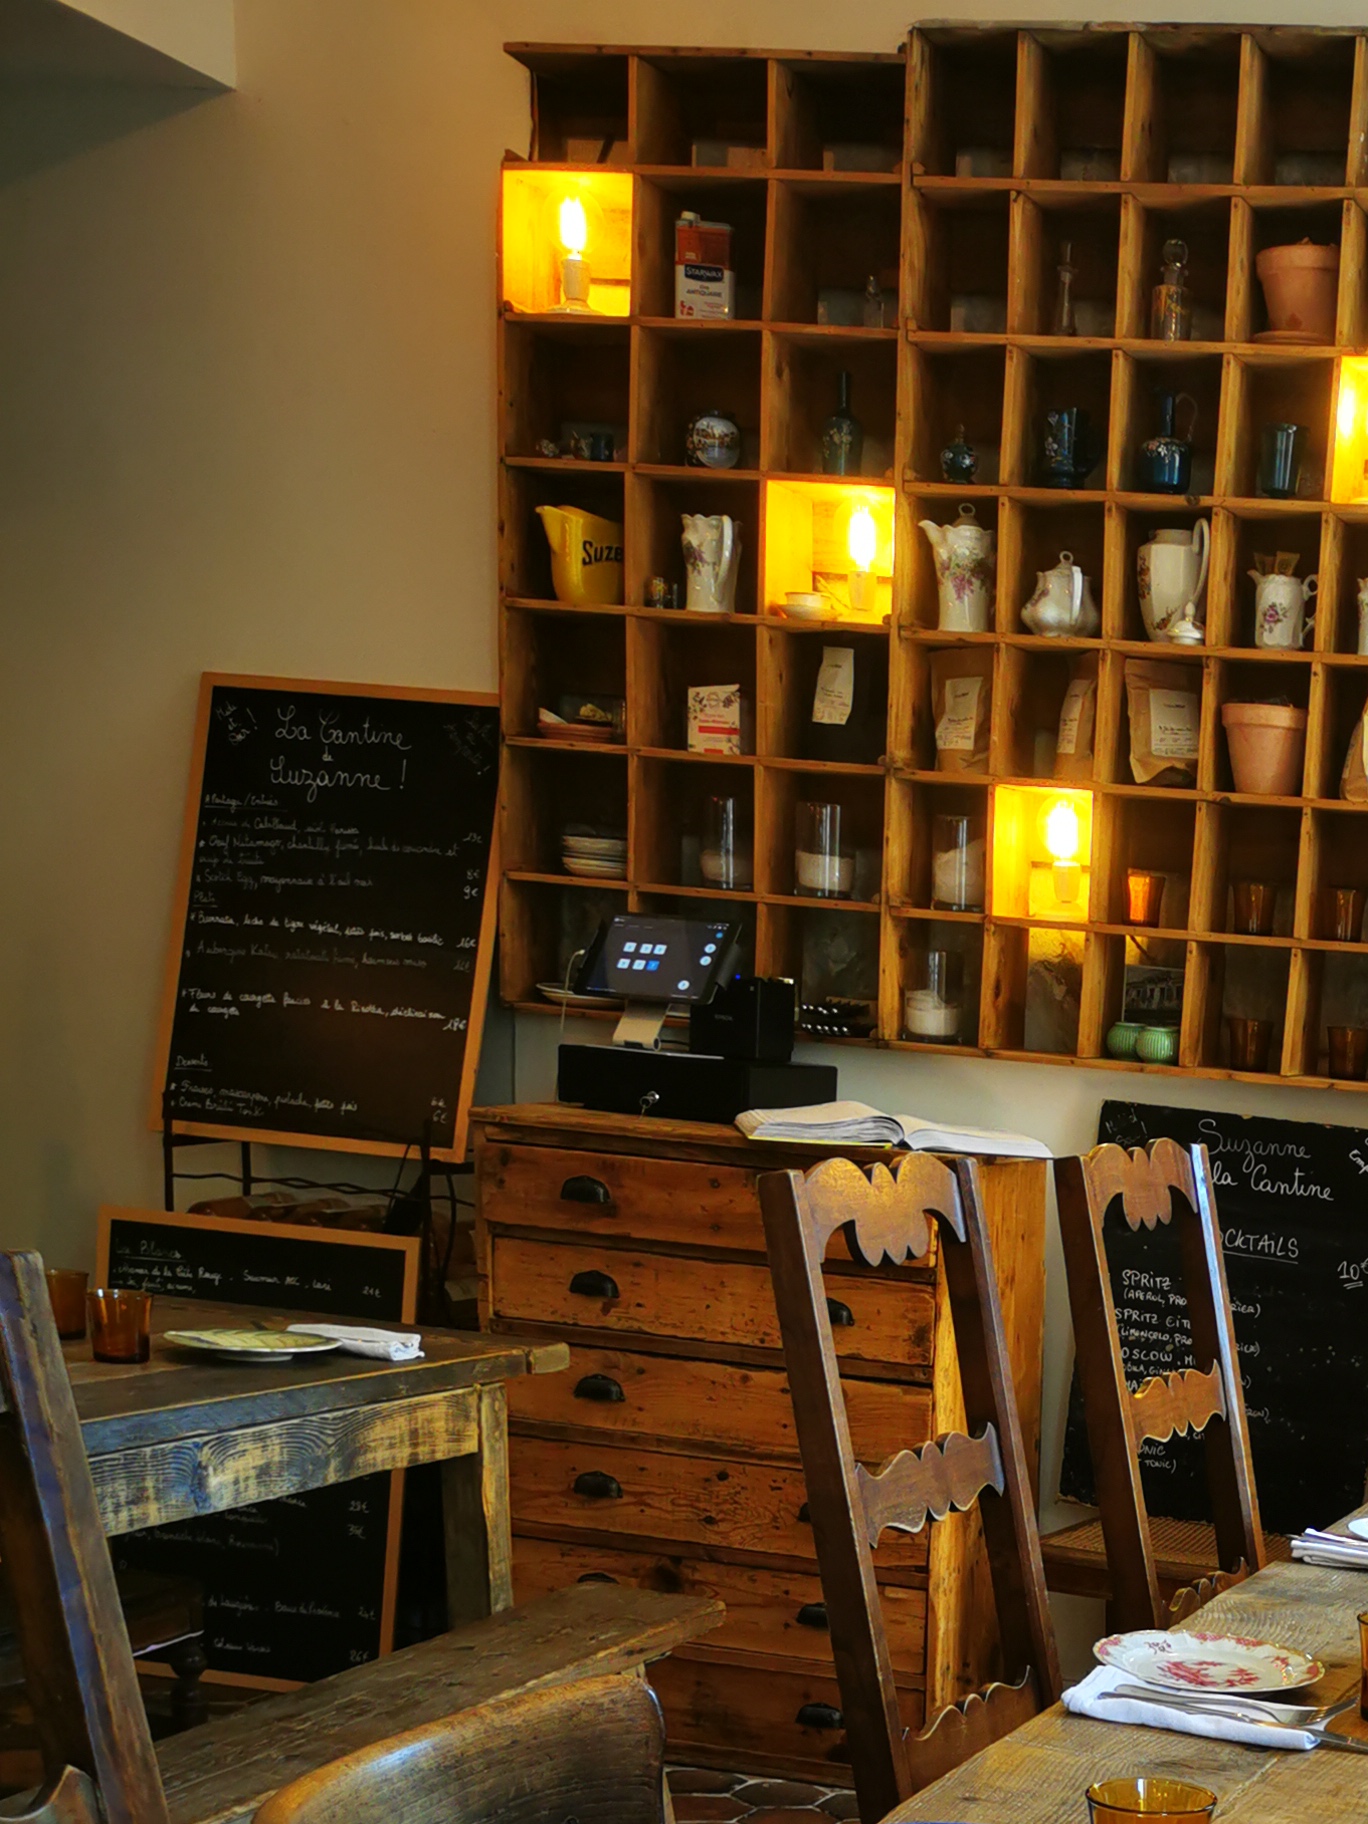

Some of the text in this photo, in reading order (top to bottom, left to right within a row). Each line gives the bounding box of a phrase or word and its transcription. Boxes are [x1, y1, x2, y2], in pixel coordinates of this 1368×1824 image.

[686, 266, 723, 279] STARWAX
[582, 540, 623, 565] Suze
[275, 705, 313, 740] La
[318, 707, 413, 751] Cantine
[269, 755, 392, 804] Suzanne
[1196, 1118, 1312, 1174] Suzanne
[1249, 1162, 1335, 1202] Cantine
